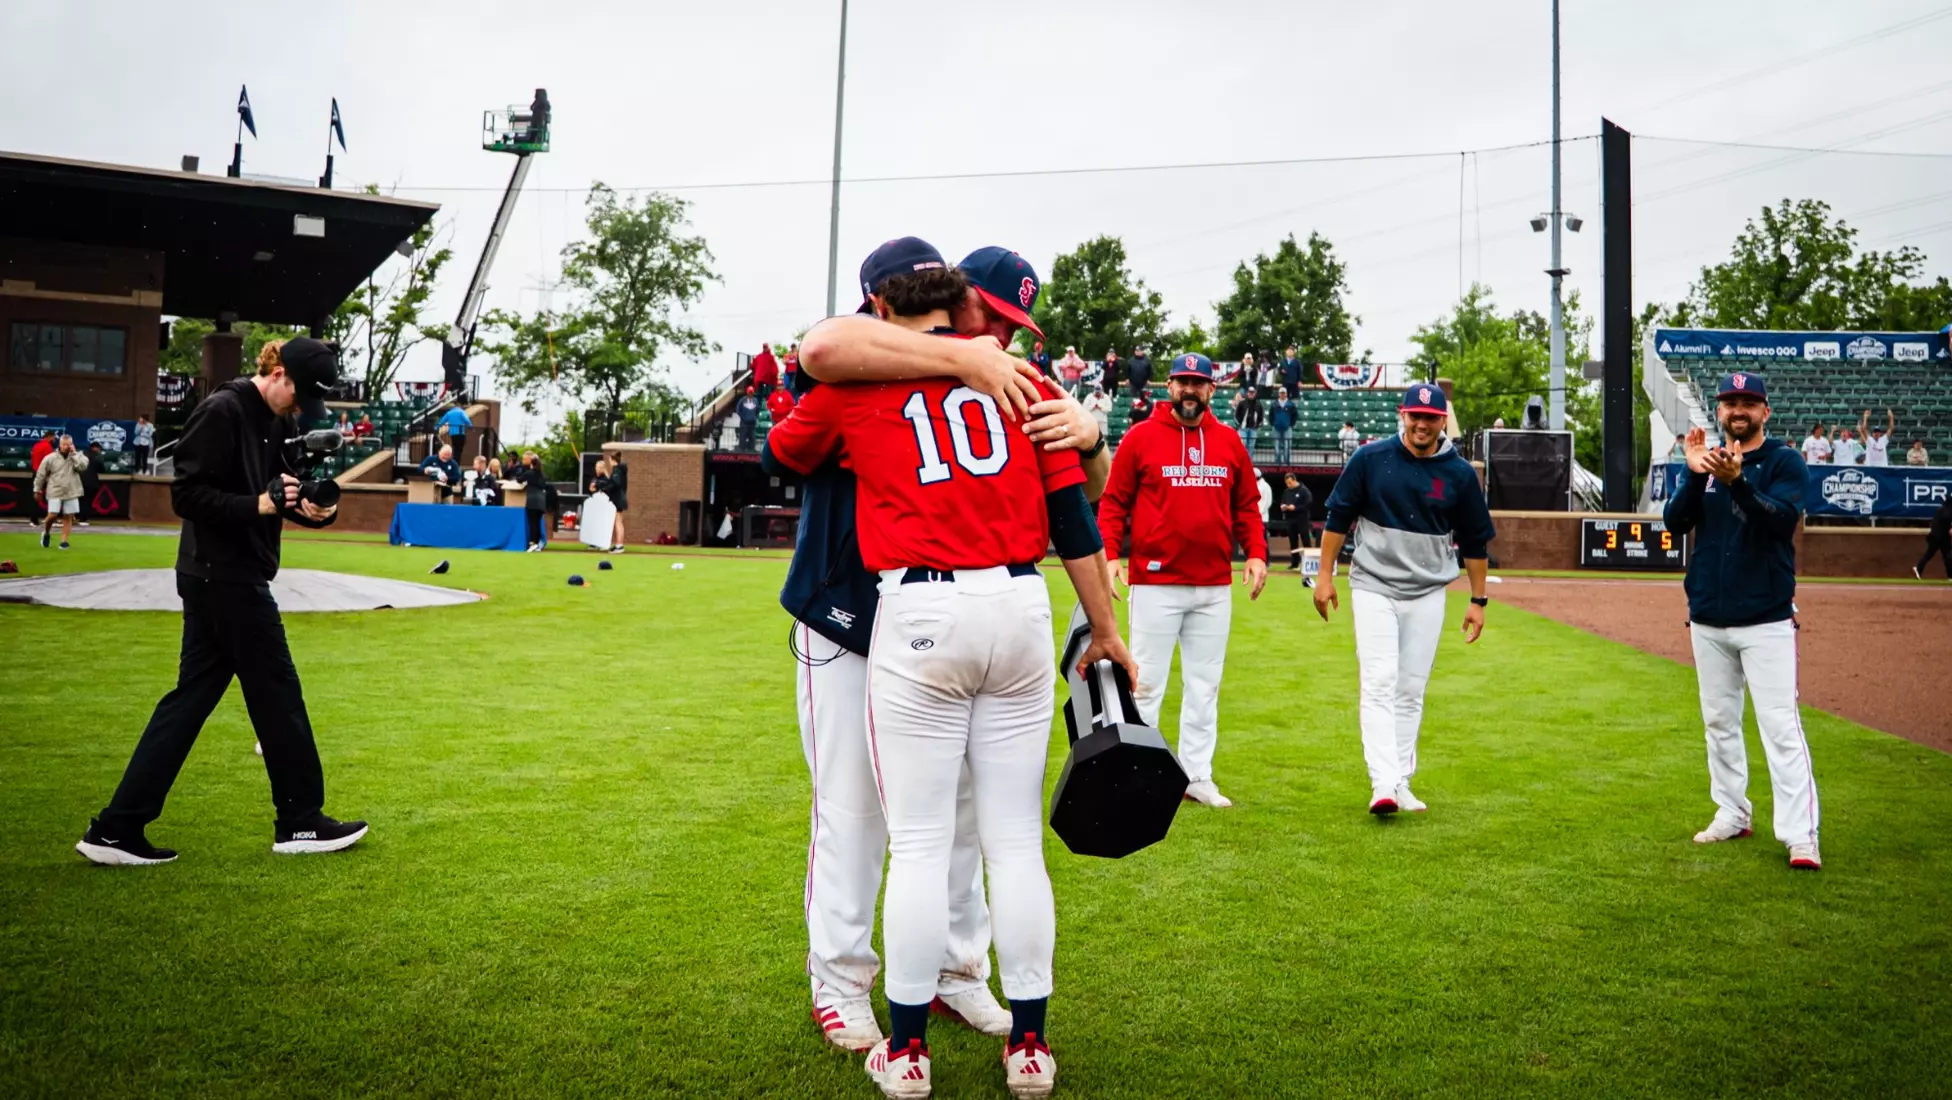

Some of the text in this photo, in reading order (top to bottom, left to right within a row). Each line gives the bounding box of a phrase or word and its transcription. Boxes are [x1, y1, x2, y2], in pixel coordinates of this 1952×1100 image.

[1737, 345, 1797, 356] Invesco QQQ
[1808, 346, 1836, 356] Jeep
[1898, 346, 1925, 357] Jeep
[0, 427, 18, 437] CO
[902, 386, 1010, 486] 10
[1162, 465, 1188, 477] RED
[1171, 477, 1222, 487] BASEALL
[1824, 481, 1877, 495] CHAMPIONSHIP
[1914, 485, 1948, 501] PR
[1595, 521, 1618, 531] GUEST
[1605, 523, 1672, 549] 3 9 5
[1592, 549, 1608, 557] BALL
[1666, 550, 1680, 558] OUT
[292, 831, 318, 840] HOKA
